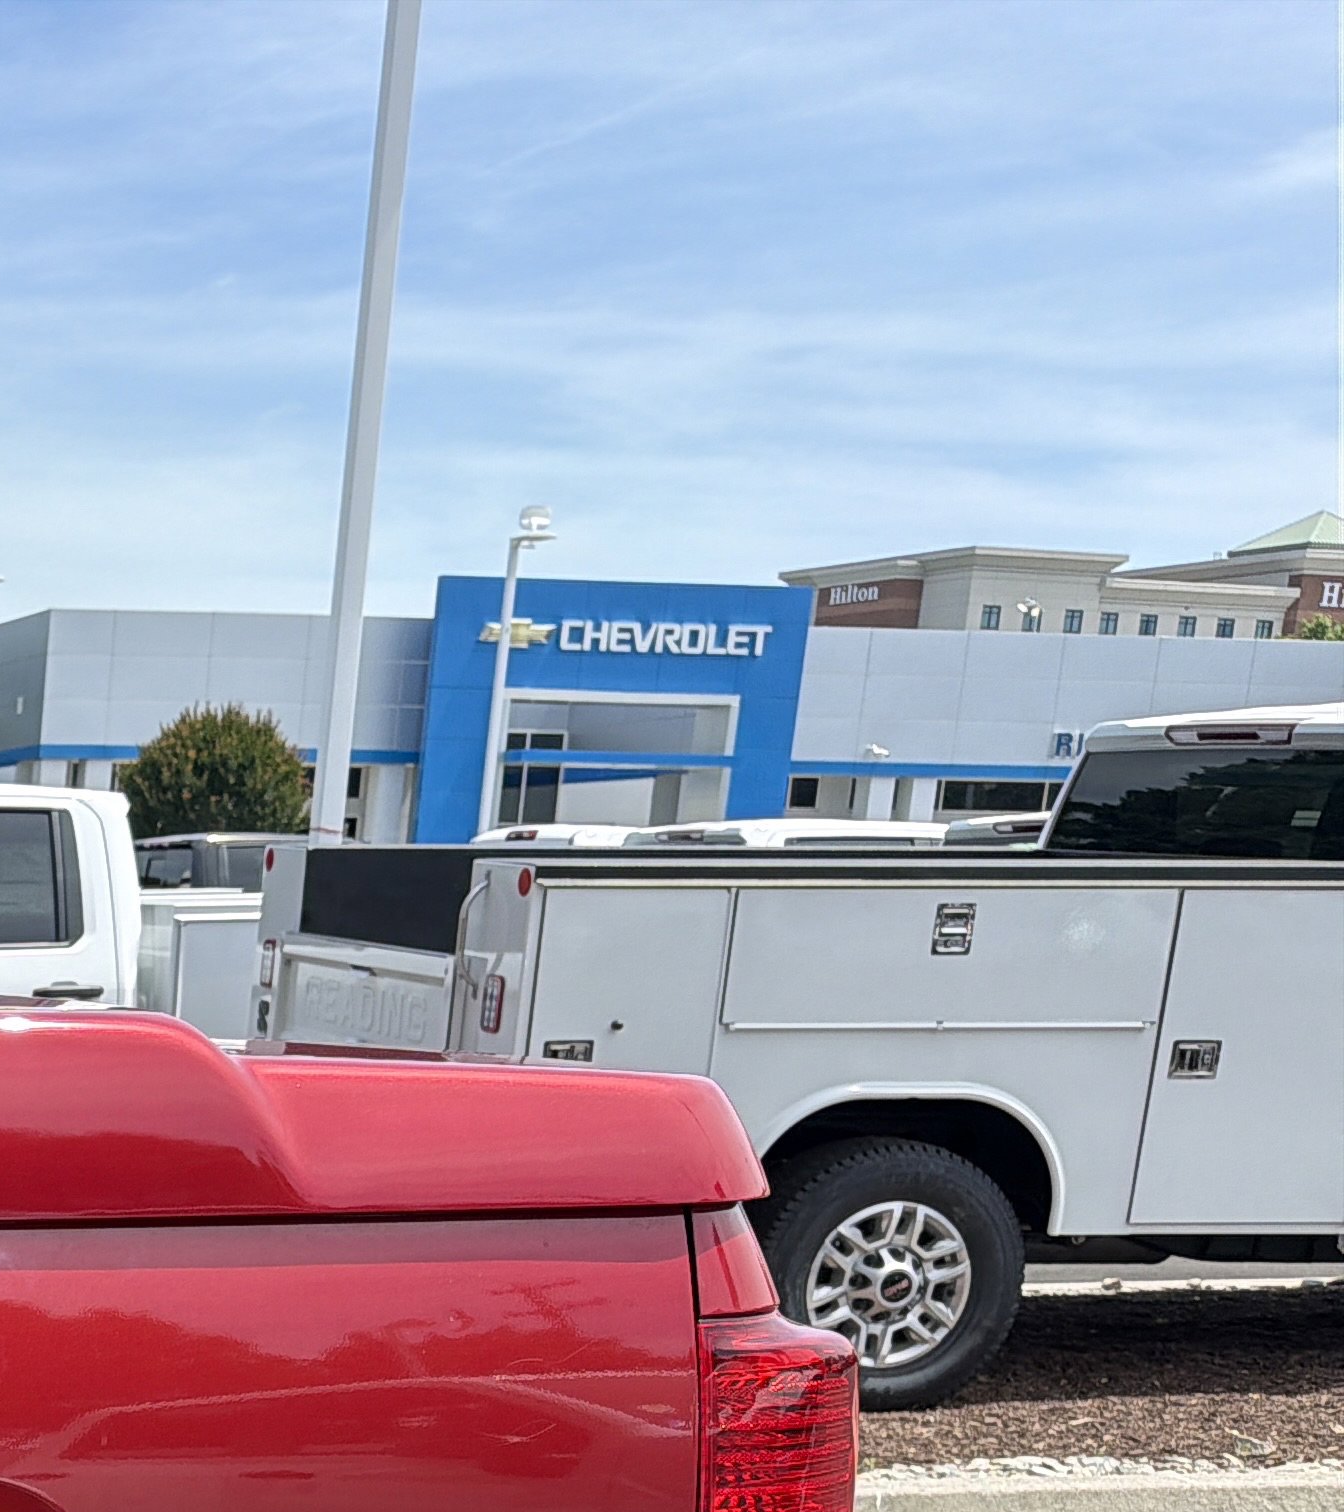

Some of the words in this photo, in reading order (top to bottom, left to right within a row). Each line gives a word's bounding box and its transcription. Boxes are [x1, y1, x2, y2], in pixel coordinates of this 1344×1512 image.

[829, 583, 880, 606] Hilton
[559, 618, 774, 657] CHEVROLET
[305, 976, 428, 1044] READING
